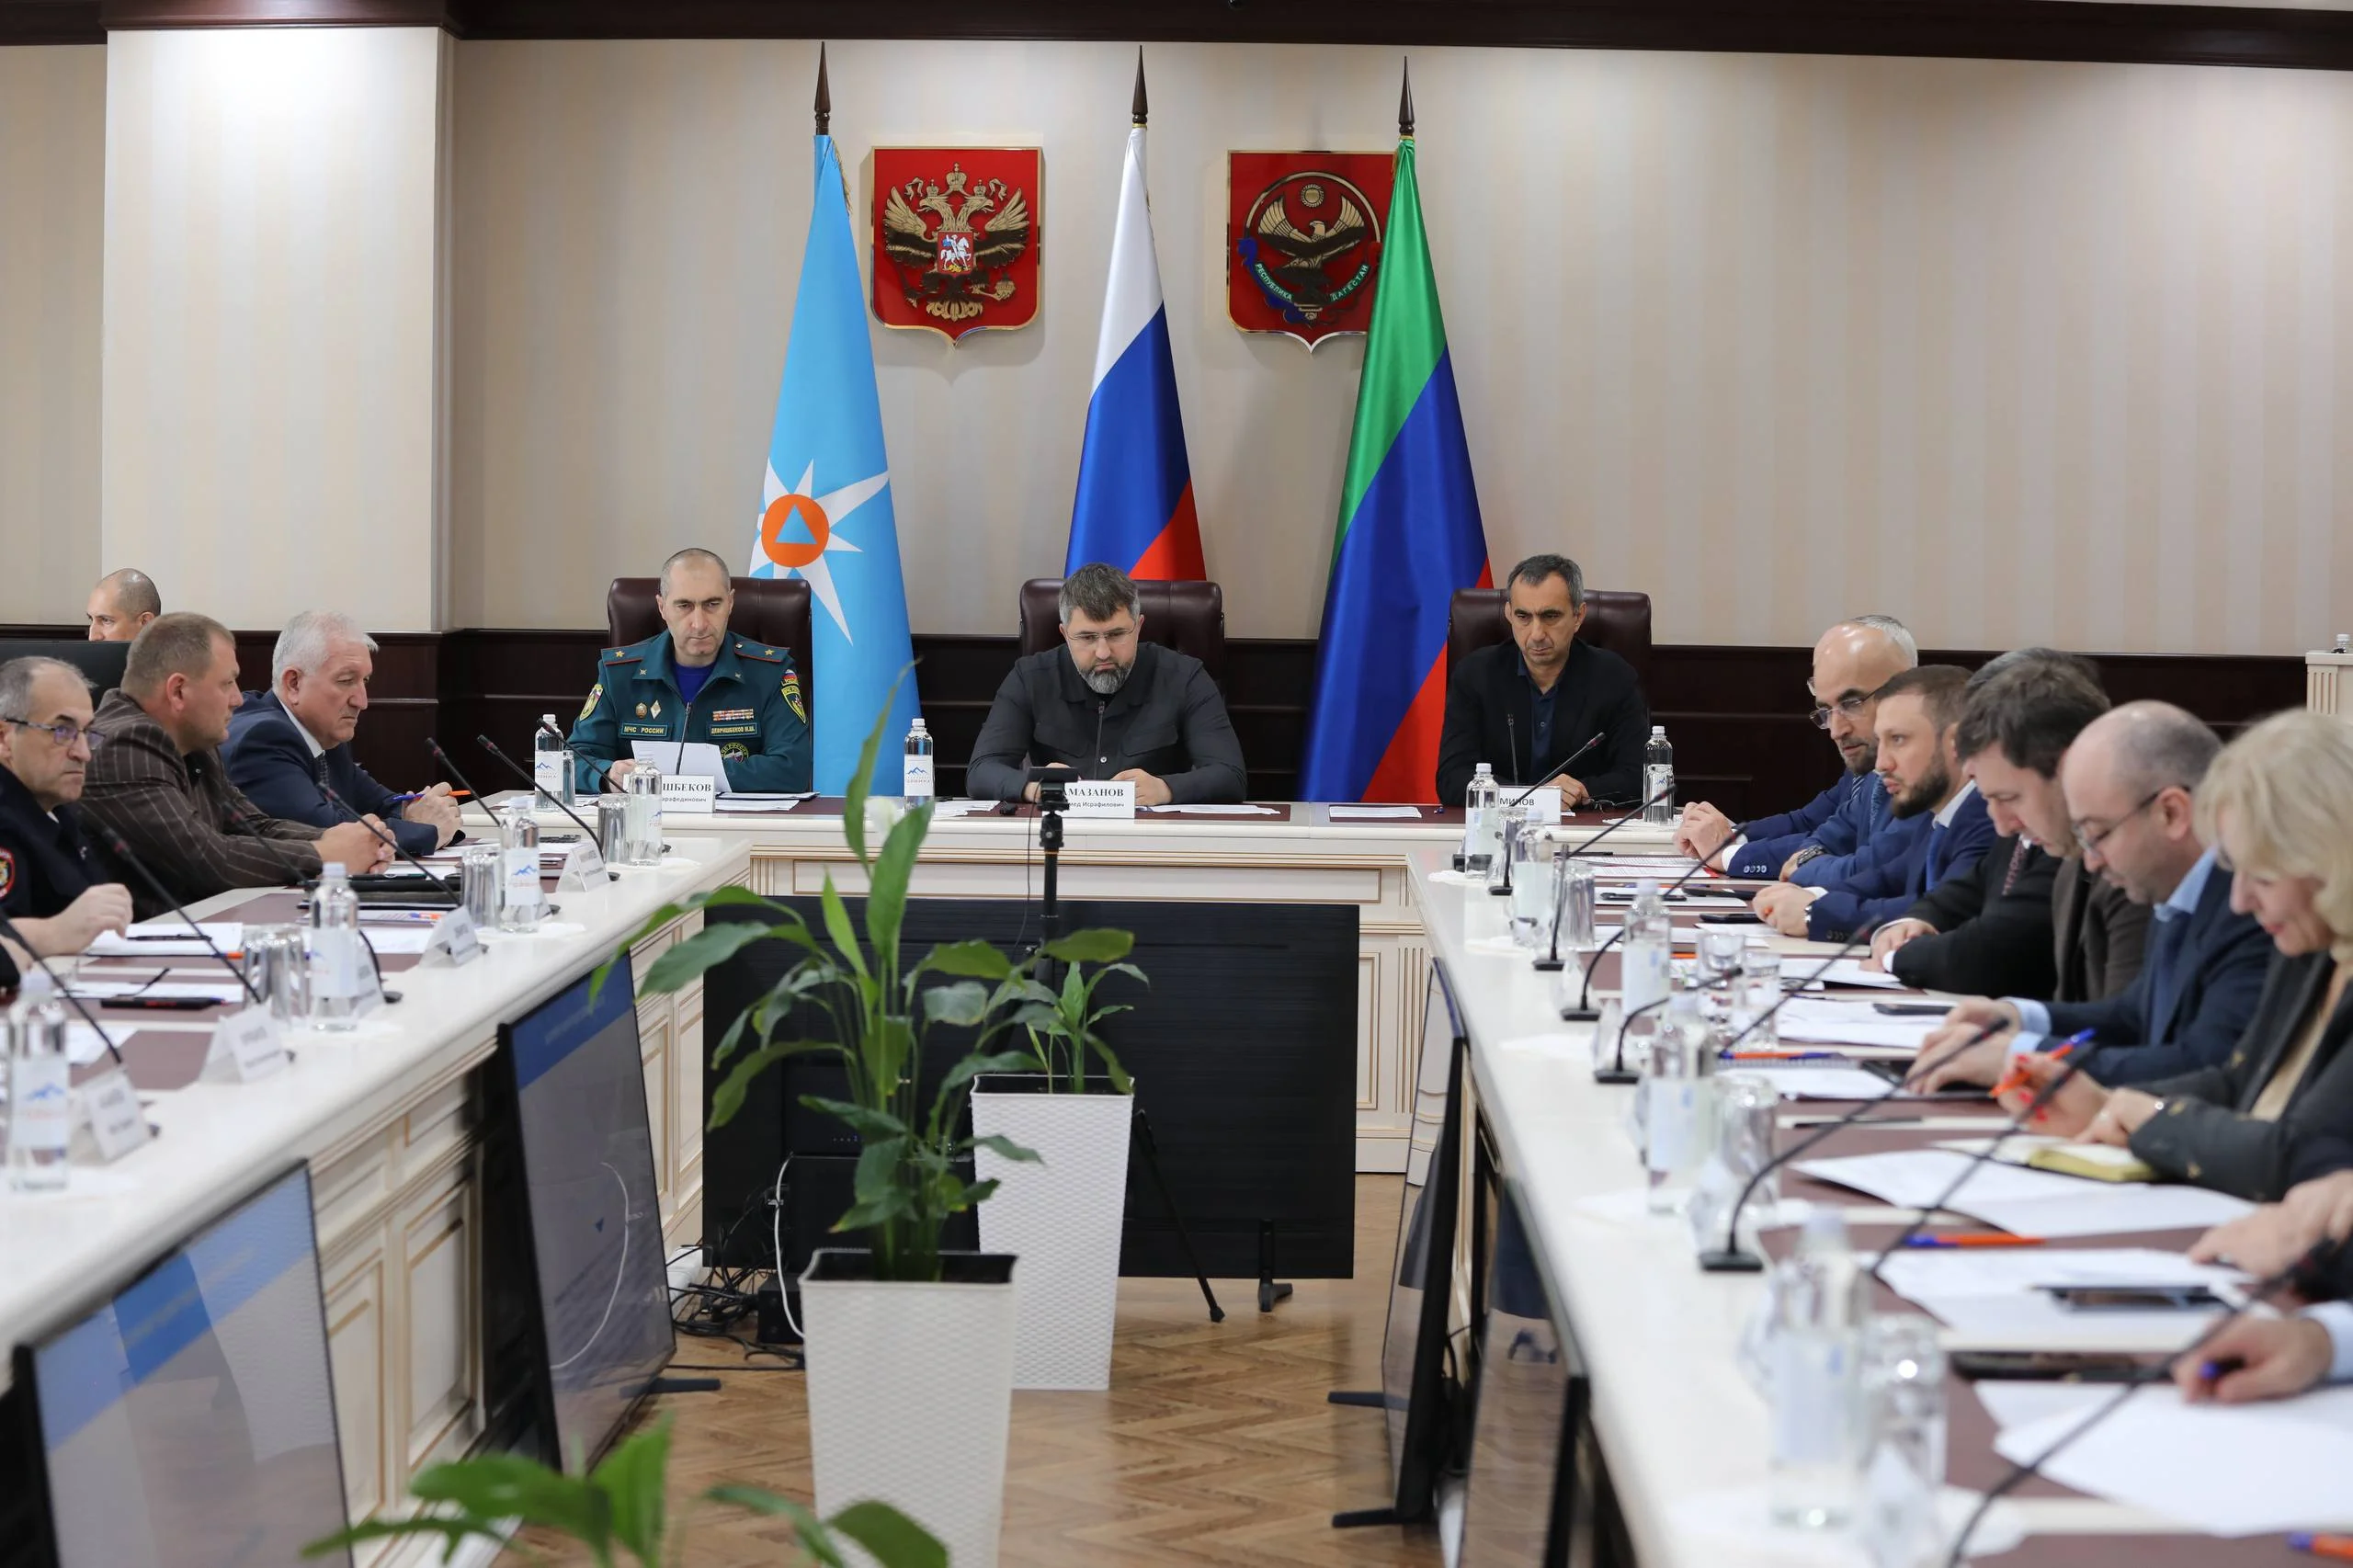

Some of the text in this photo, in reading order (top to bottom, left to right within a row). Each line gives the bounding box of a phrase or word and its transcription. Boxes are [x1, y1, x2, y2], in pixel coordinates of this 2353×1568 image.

[1255, 263, 1369, 301] РЕСПУБЛИКА ДАГЕСТАН
[624, 725, 637, 733] МЧС
[662, 783, 711, 792] ШБЕКОВ
[1064, 788, 1124, 797] МАЗАНОВ
[1499, 797, 1535, 806] МИОВ
